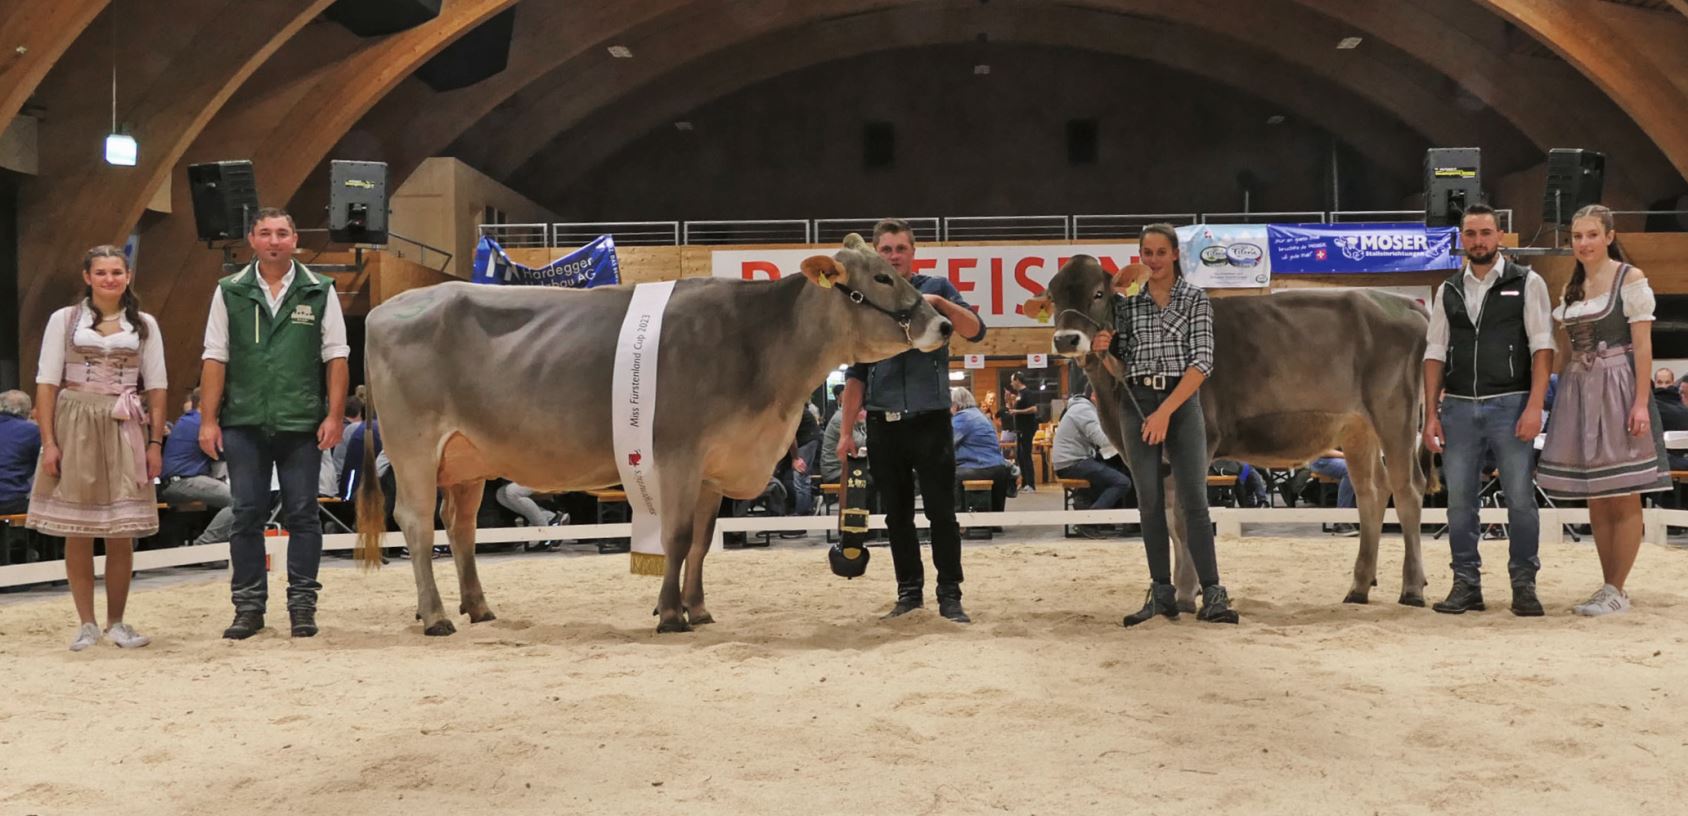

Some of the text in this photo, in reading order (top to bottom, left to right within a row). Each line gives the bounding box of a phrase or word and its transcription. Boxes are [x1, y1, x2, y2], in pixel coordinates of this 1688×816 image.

[1361, 235, 1428, 250] MOSER
[523, 257, 593, 279] Hardegger
[578, 268, 597, 283] AG
[637, 314, 651, 332] 2023
[633, 334, 646, 350] Cup
[630, 407, 640, 428] Miss
